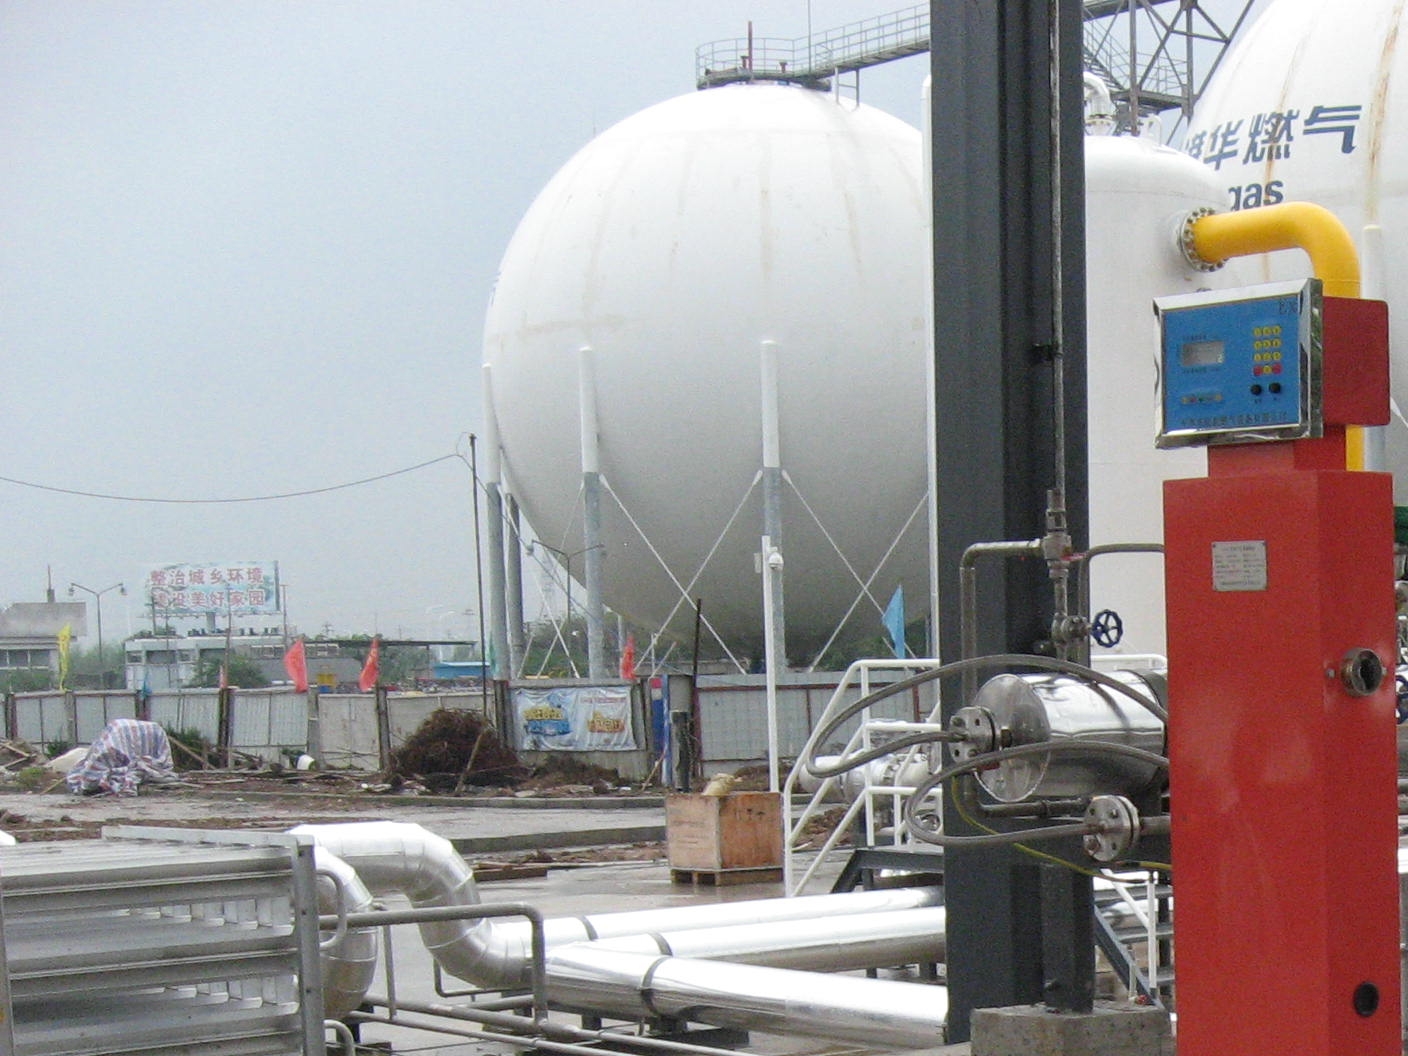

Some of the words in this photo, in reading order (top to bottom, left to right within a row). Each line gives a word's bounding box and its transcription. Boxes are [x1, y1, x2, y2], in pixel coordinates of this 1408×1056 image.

[151, 566, 264, 586] 整治城乡环境
[152, 590, 265, 609] 建设美好家园
